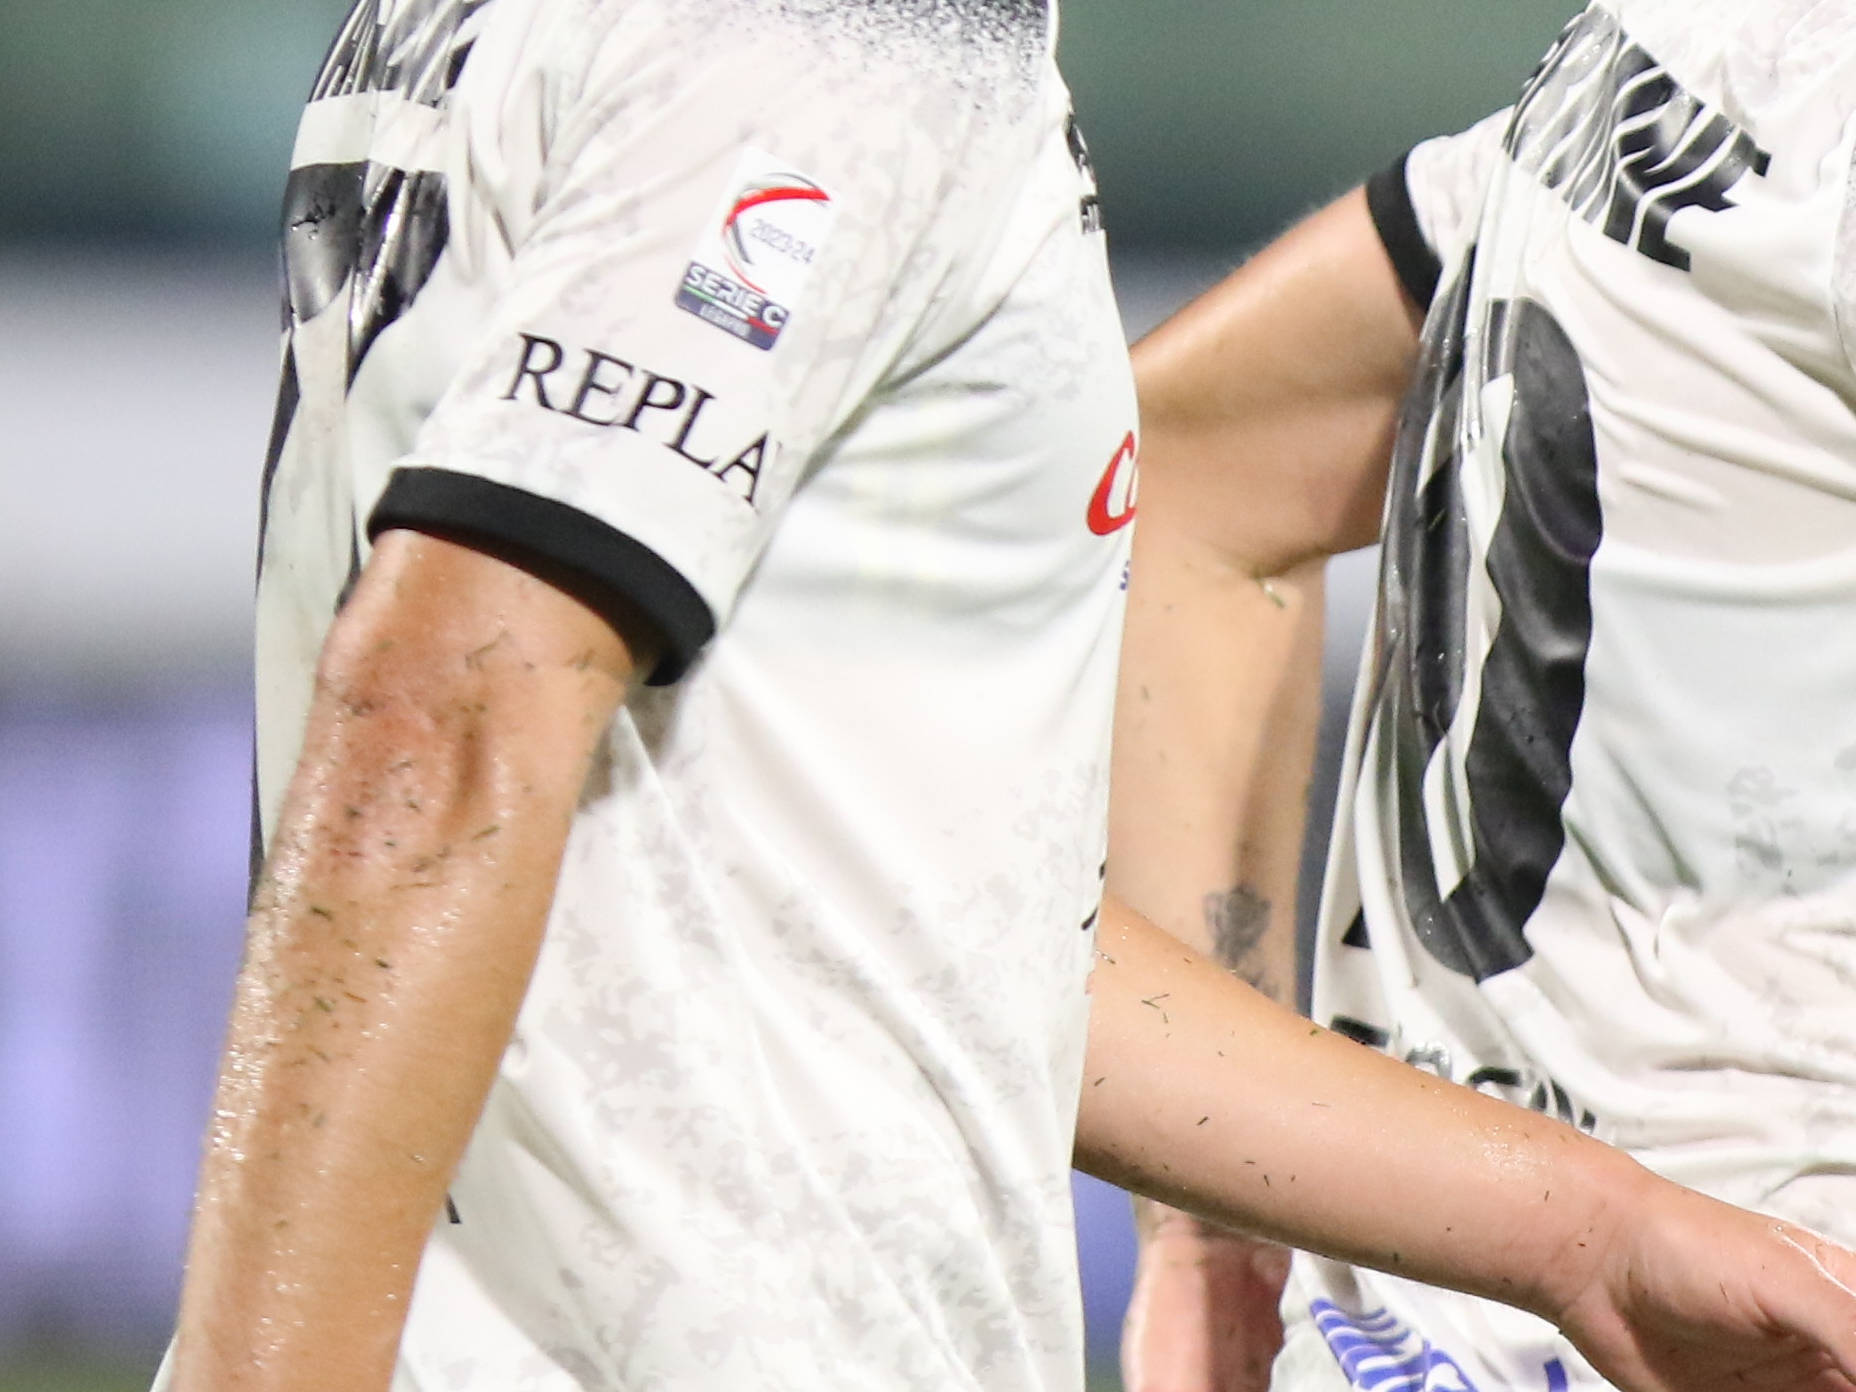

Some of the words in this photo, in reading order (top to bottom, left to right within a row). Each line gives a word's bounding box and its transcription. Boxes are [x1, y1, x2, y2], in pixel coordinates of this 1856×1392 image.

[684, 264, 766, 318] SERIE
[761, 305, 787, 328] C
[500, 330, 772, 508] REPLA
